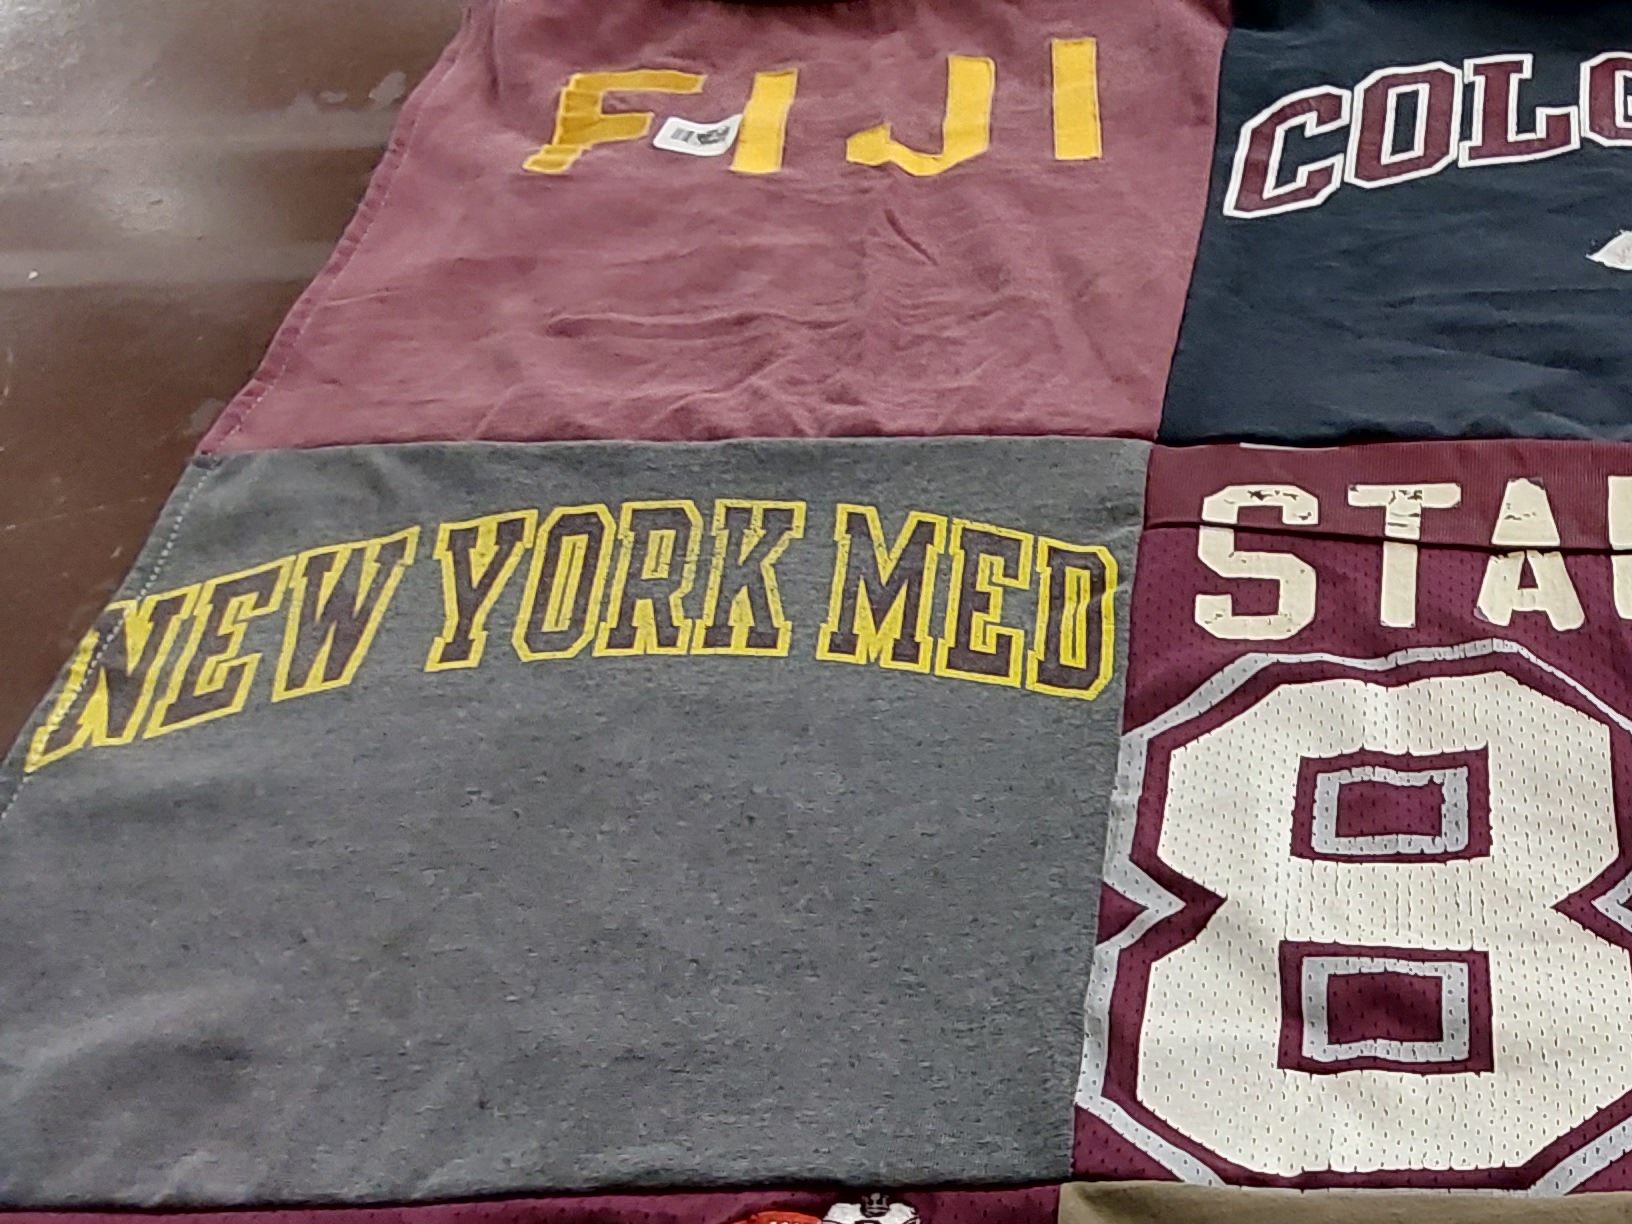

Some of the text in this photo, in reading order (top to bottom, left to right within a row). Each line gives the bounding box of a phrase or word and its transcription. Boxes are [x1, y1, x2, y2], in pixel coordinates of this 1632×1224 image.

[523, 37, 1103, 176] FIJI
[24, 499, 1119, 773] NEW YORK MED
